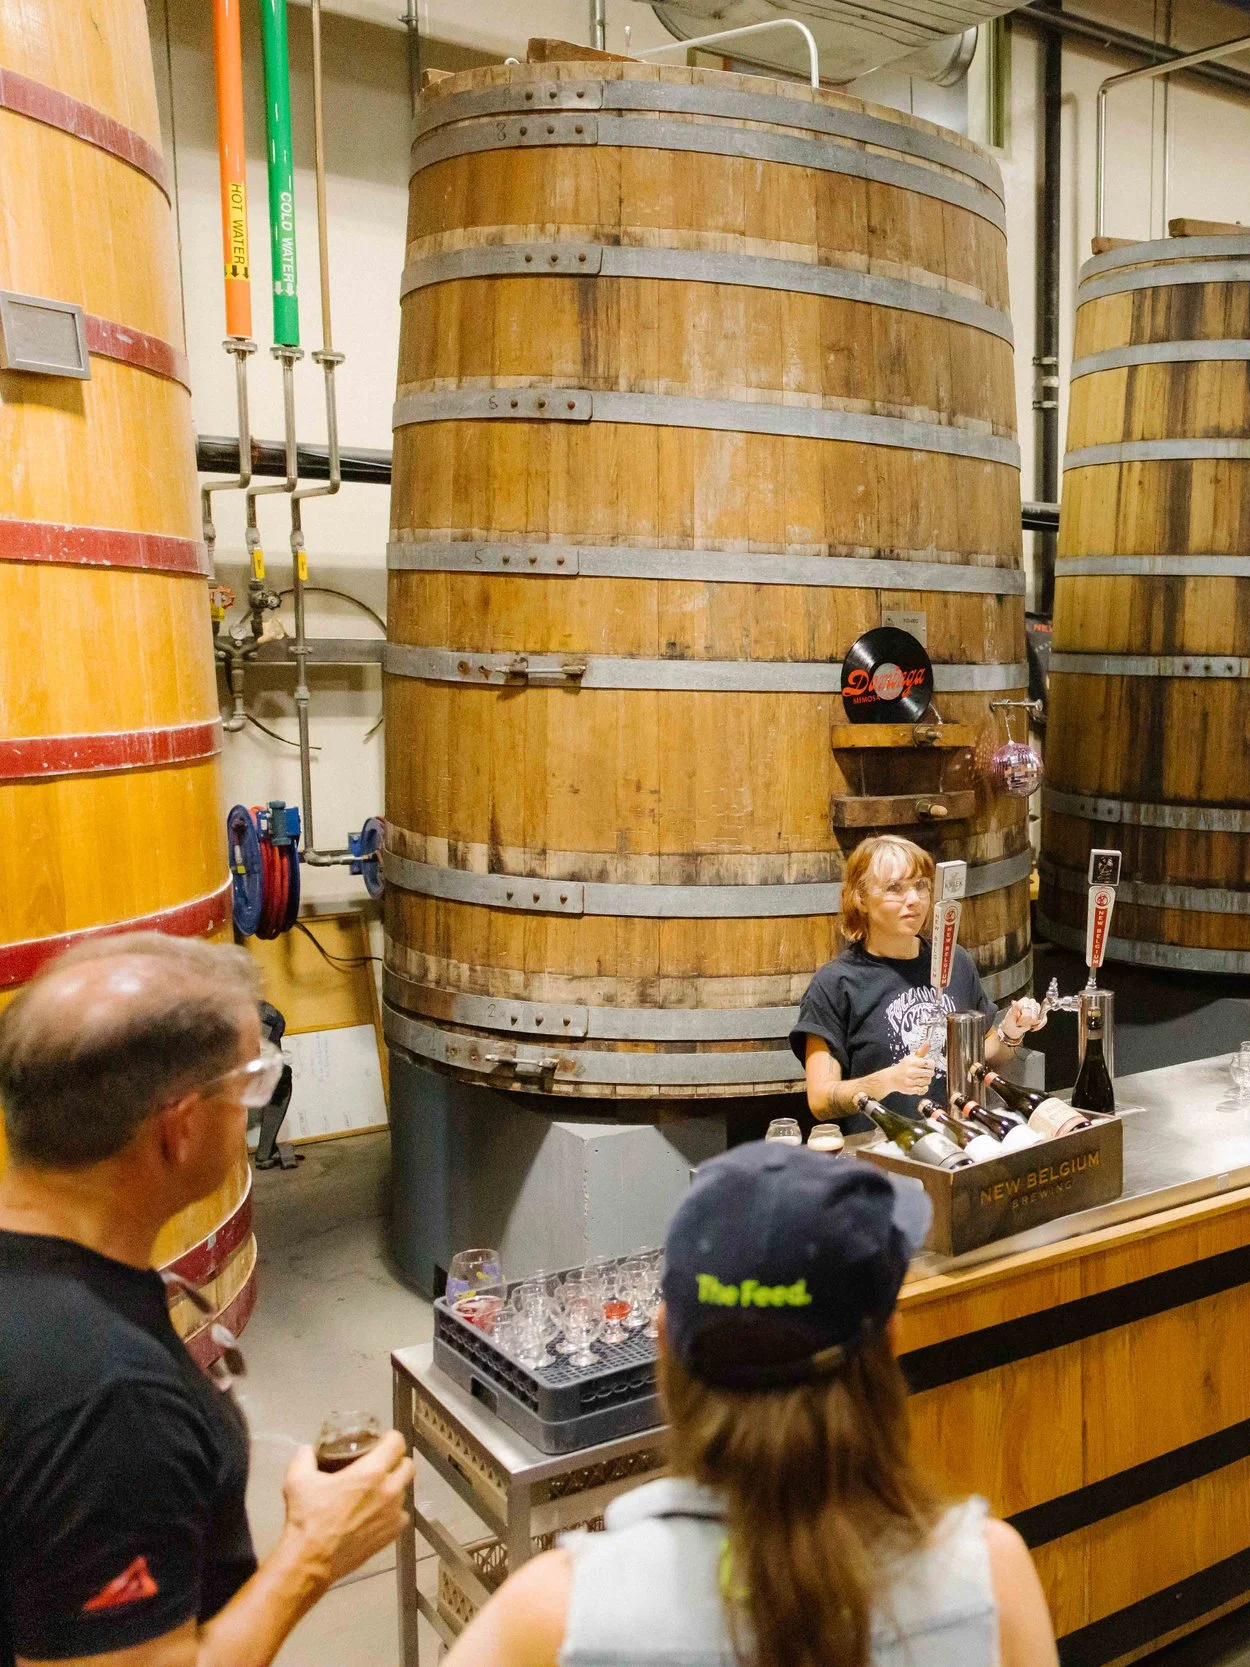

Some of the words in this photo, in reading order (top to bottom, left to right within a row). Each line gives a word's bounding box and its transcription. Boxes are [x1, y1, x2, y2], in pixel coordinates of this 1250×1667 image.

[231, 183, 243, 212] HOT
[280, 191, 292, 231] COLD
[232, 219, 245, 265] WATER
[282, 237, 295, 283] WATER
[842, 665, 926, 697] Dominga
[853, 695, 881, 705] MIMOSA
[945, 926, 953, 943] NEW
[1097, 910, 1105, 926] NEW
[1092, 928, 1102, 965] BELGIUM
[941, 946, 950, 984] BELGIUM
[886, 987, 916, 1033] FULL
[915, 986, 957, 1014] MON
[980, 1178, 1021, 1206] NEW
[1026, 1151, 1100, 1188] BELGIUM
[1011, 1179, 1074, 1209] BREWING
[696, 1273, 739, 1307] The
